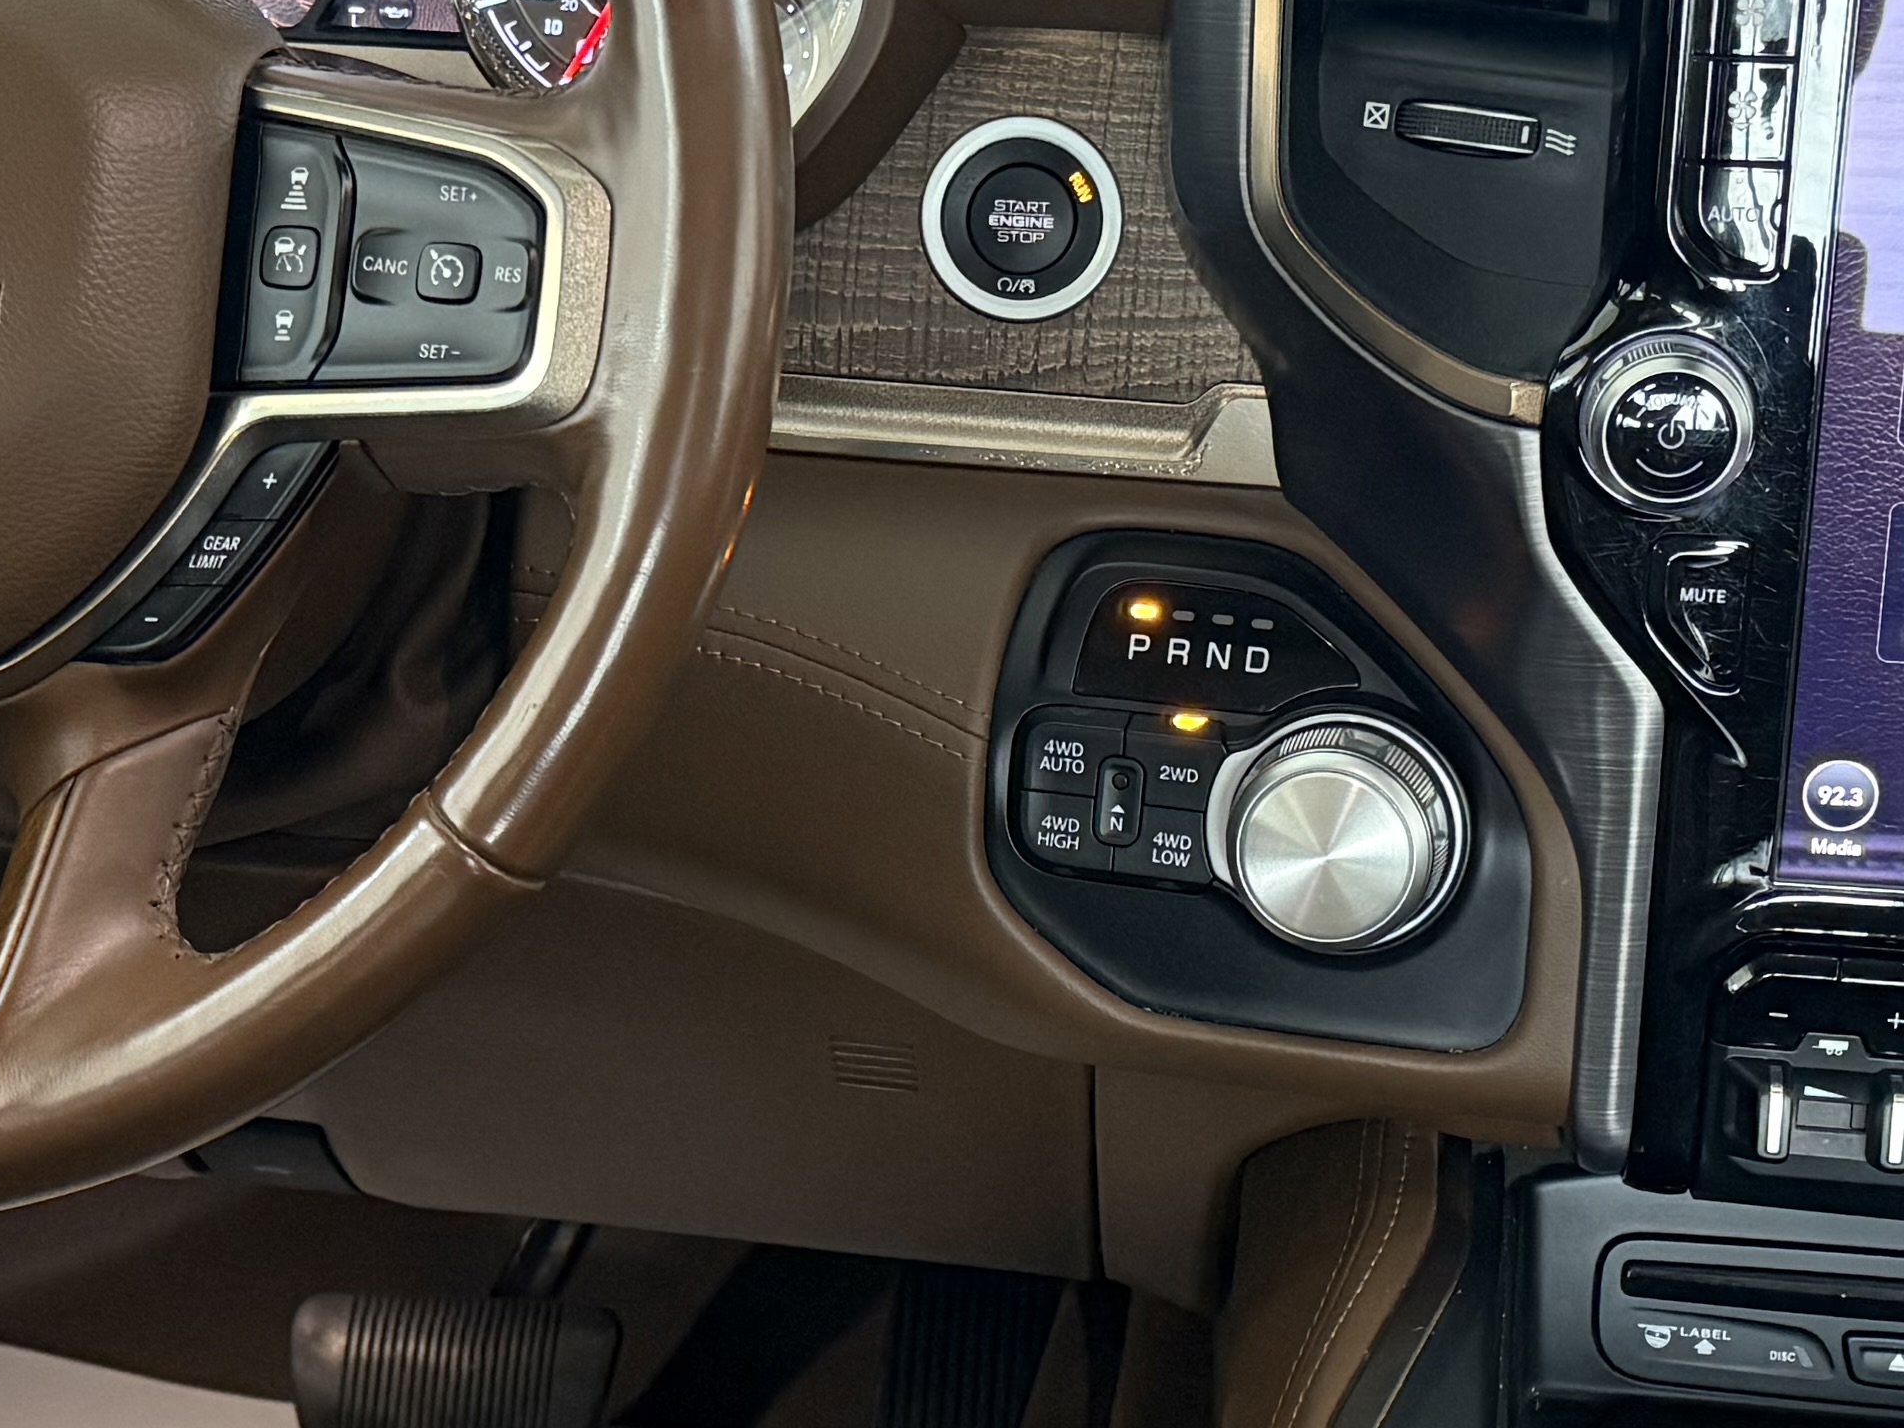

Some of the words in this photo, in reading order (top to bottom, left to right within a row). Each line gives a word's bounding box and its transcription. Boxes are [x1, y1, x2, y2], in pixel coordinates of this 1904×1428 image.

[350, 13, 361, 28] L
[543, 18, 564, 36] 10
[1068, 171, 1093, 204] RUN
[993, 199, 1051, 214] START
[1707, 204, 1761, 223] AUTO
[988, 215, 1055, 229] ENGINE
[996, 231, 1045, 244] STOP
[362, 255, 408, 276] CANC
[494, 266, 522, 285] RES
[203, 535, 241, 553] GEAR
[189, 553, 229, 570] LIMIT
[1679, 588, 1727, 605] MUTE
[1127, 634, 1151, 660] P
[1166, 637, 1191, 666] R
[1205, 641, 1232, 670] N
[1244, 645, 1270, 674] D
[1043, 739, 1084, 758] 4WD
[1039, 756, 1085, 775] AUTO
[1158, 765, 1199, 783] 2WD
[1817, 785, 1864, 808] 92.3
[1040, 814, 1080, 833] 4WD
[1109, 816, 1124, 832] N
[1036, 831, 1080, 851] HIGH
[1152, 831, 1192, 851] 4WD
[1810, 837, 1862, 857] Media
[1151, 849, 1191, 868] LOW
[1680, 1326, 1731, 1341] LABEL
[1769, 1350, 1797, 1363] DISC
